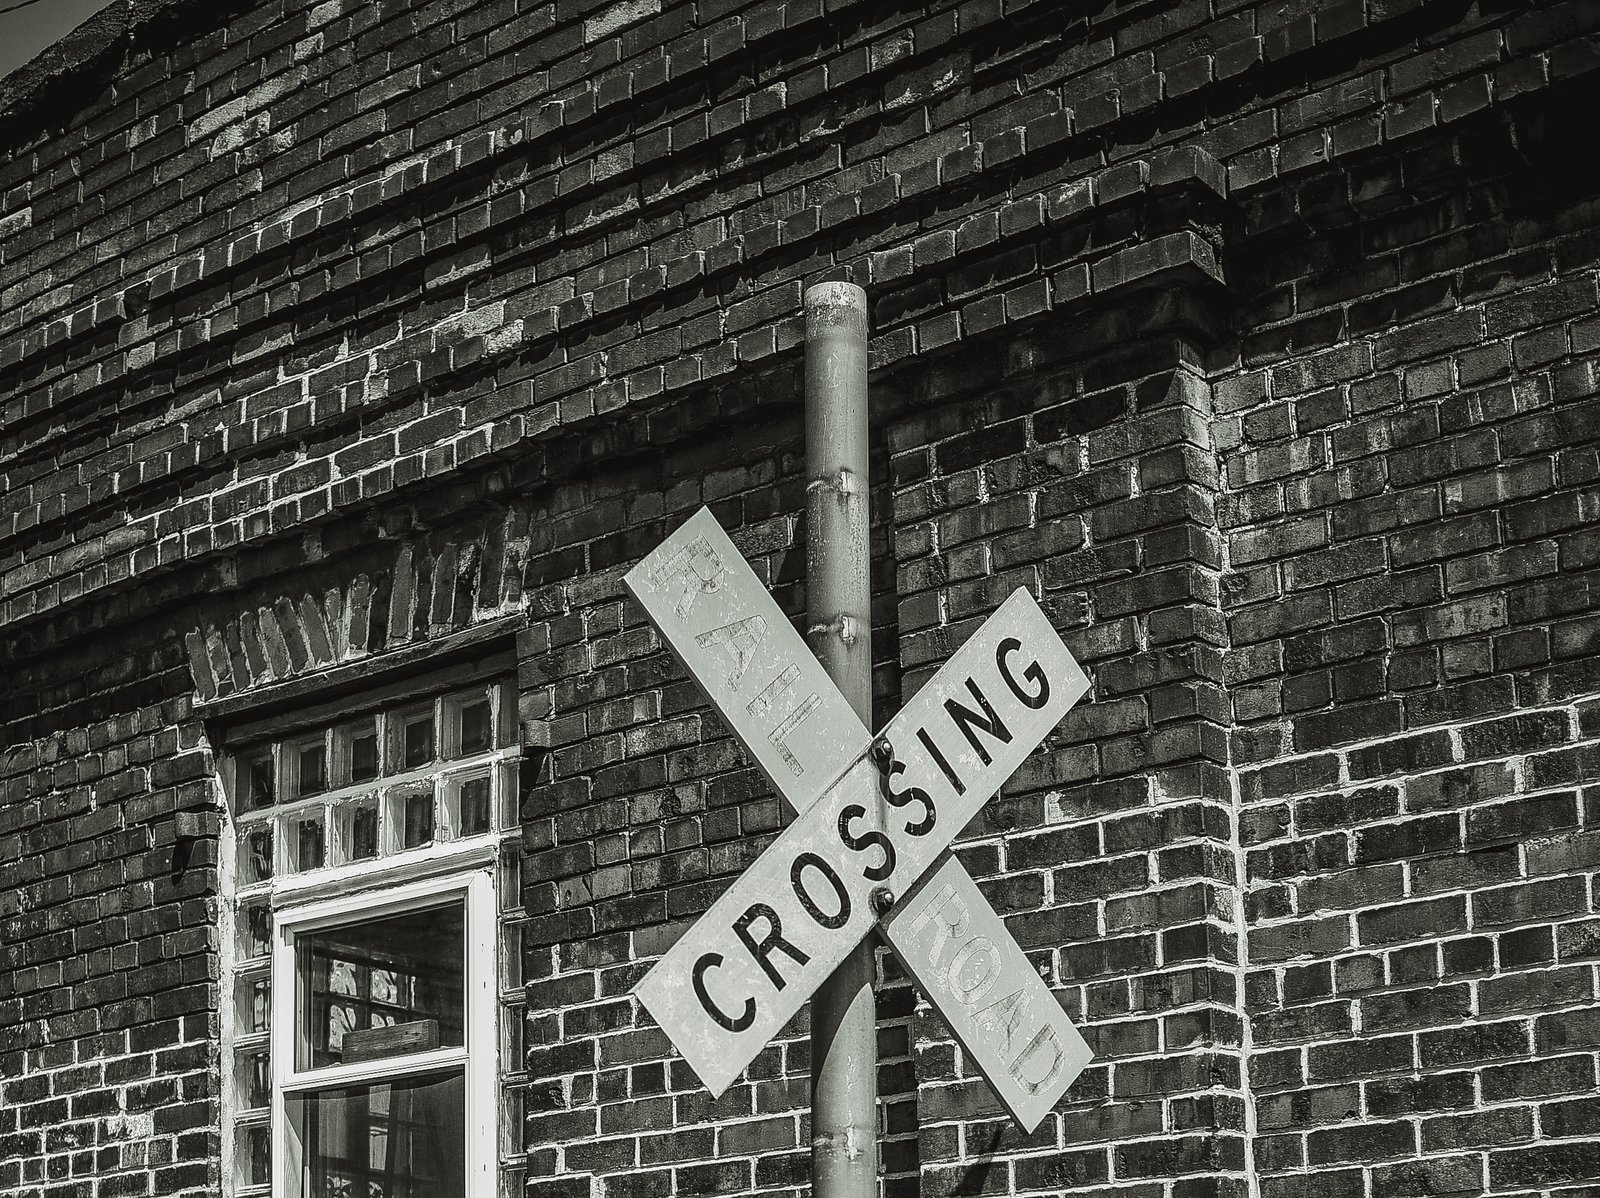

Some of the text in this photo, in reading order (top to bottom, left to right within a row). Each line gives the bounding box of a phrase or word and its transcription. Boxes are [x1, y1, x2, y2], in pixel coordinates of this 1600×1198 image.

[653, 533, 1066, 1096] RAIL ROAD
[691, 636, 1051, 1033] CROSSING
